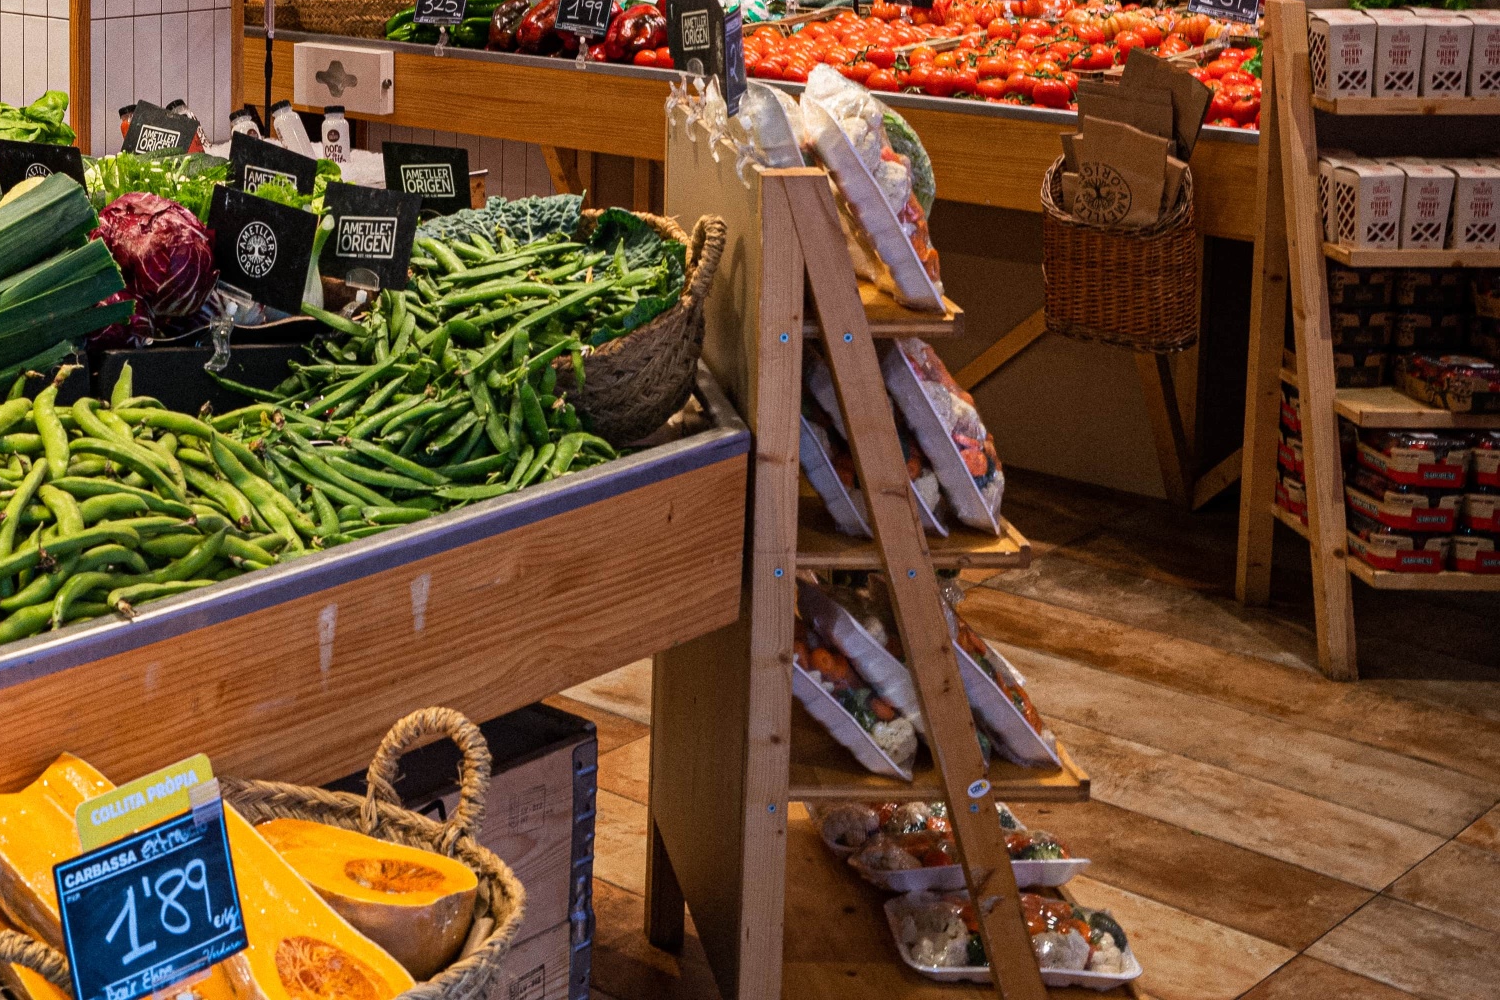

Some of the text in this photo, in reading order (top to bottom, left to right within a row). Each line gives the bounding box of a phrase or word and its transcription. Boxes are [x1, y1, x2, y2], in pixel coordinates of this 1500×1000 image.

[684, 27, 708, 45] ORIGEN
[142, 127, 177, 147] AMETLLER
[405, 167, 449, 180] AMETLLER
[406, 178, 451, 194] ORIGEN
[341, 234, 393, 253] ORIGEN
[90, 769, 199, 827] COLLITA PRÒPIA
[64, 827, 190, 889] CARBASSA extra
